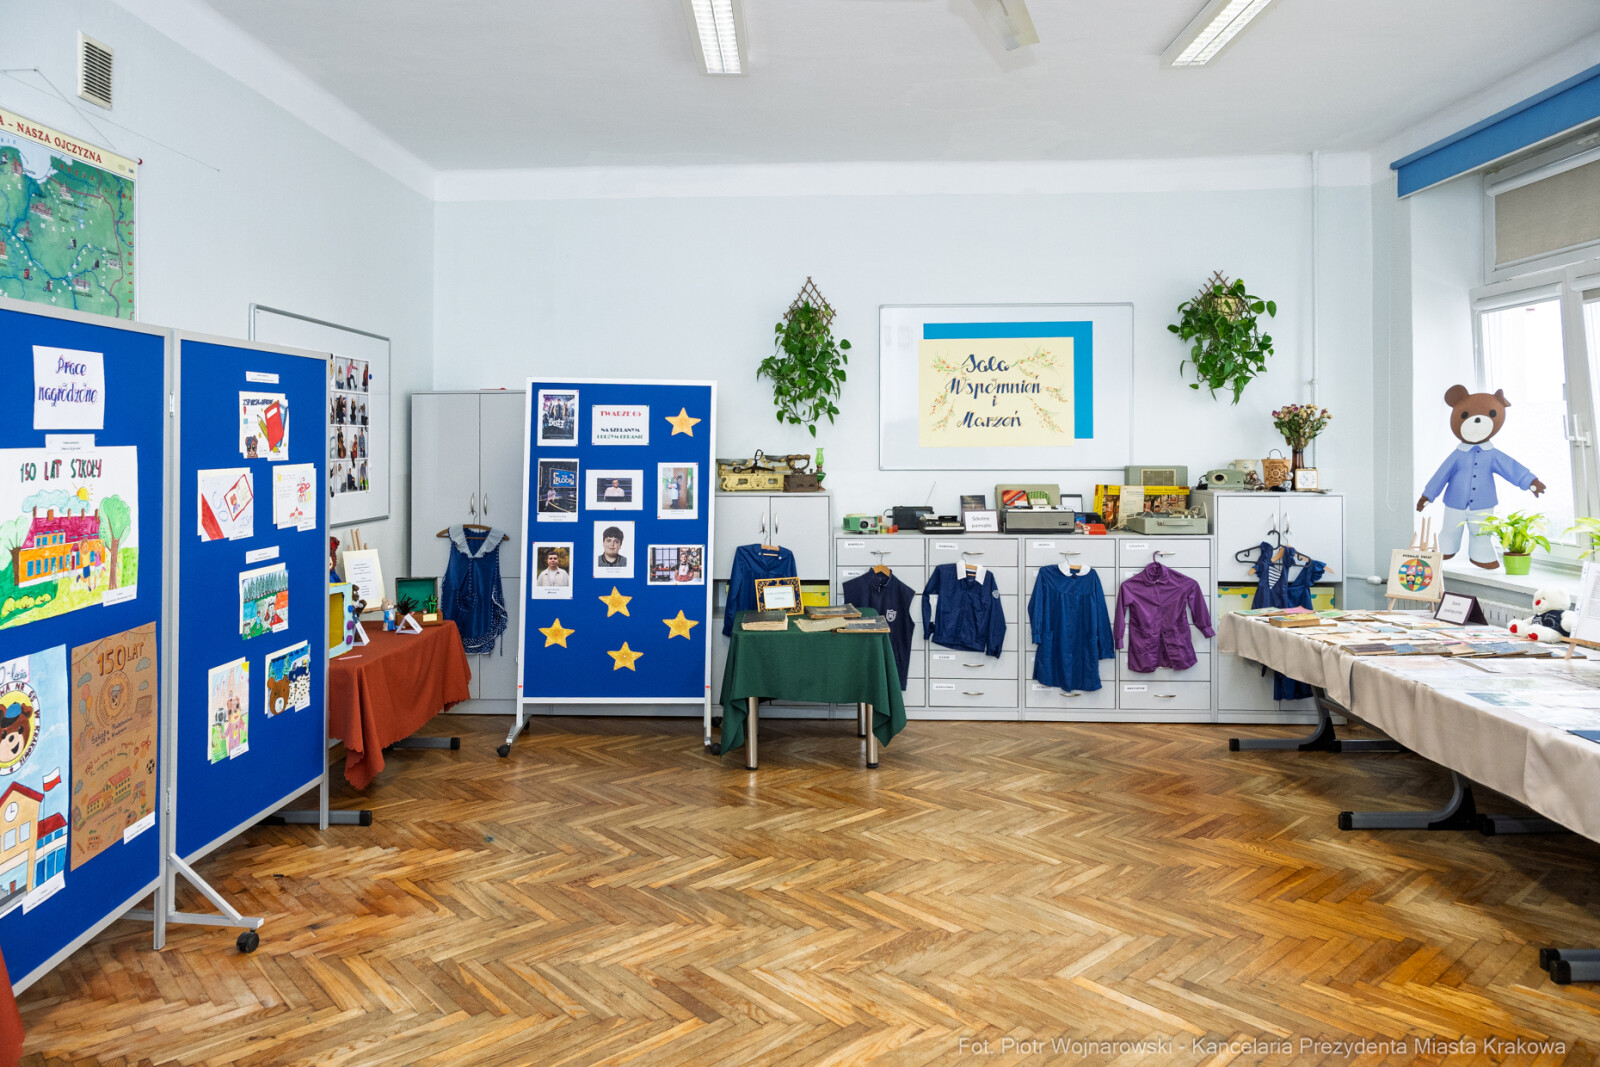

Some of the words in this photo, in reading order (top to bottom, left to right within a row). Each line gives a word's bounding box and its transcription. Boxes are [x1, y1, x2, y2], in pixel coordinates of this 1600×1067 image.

[16, 121, 51, 144] NASZA
[54, 137, 102, 164] OJCZYZNA
[55, 354, 87, 376] Prace
[961, 354, 1010, 373] Sala
[38, 381, 98, 407] nagrodzone
[945, 375, 1042, 400] Wspomnień
[991, 396, 998, 407] i
[957, 410, 1023, 429] Marzeń
[20, 462, 37, 483] 150
[44, 459, 62, 481] LAT
[70, 458, 103, 479] SZKOŁY
[96, 644, 127, 676] 150
[127, 641, 145, 662] LAT
